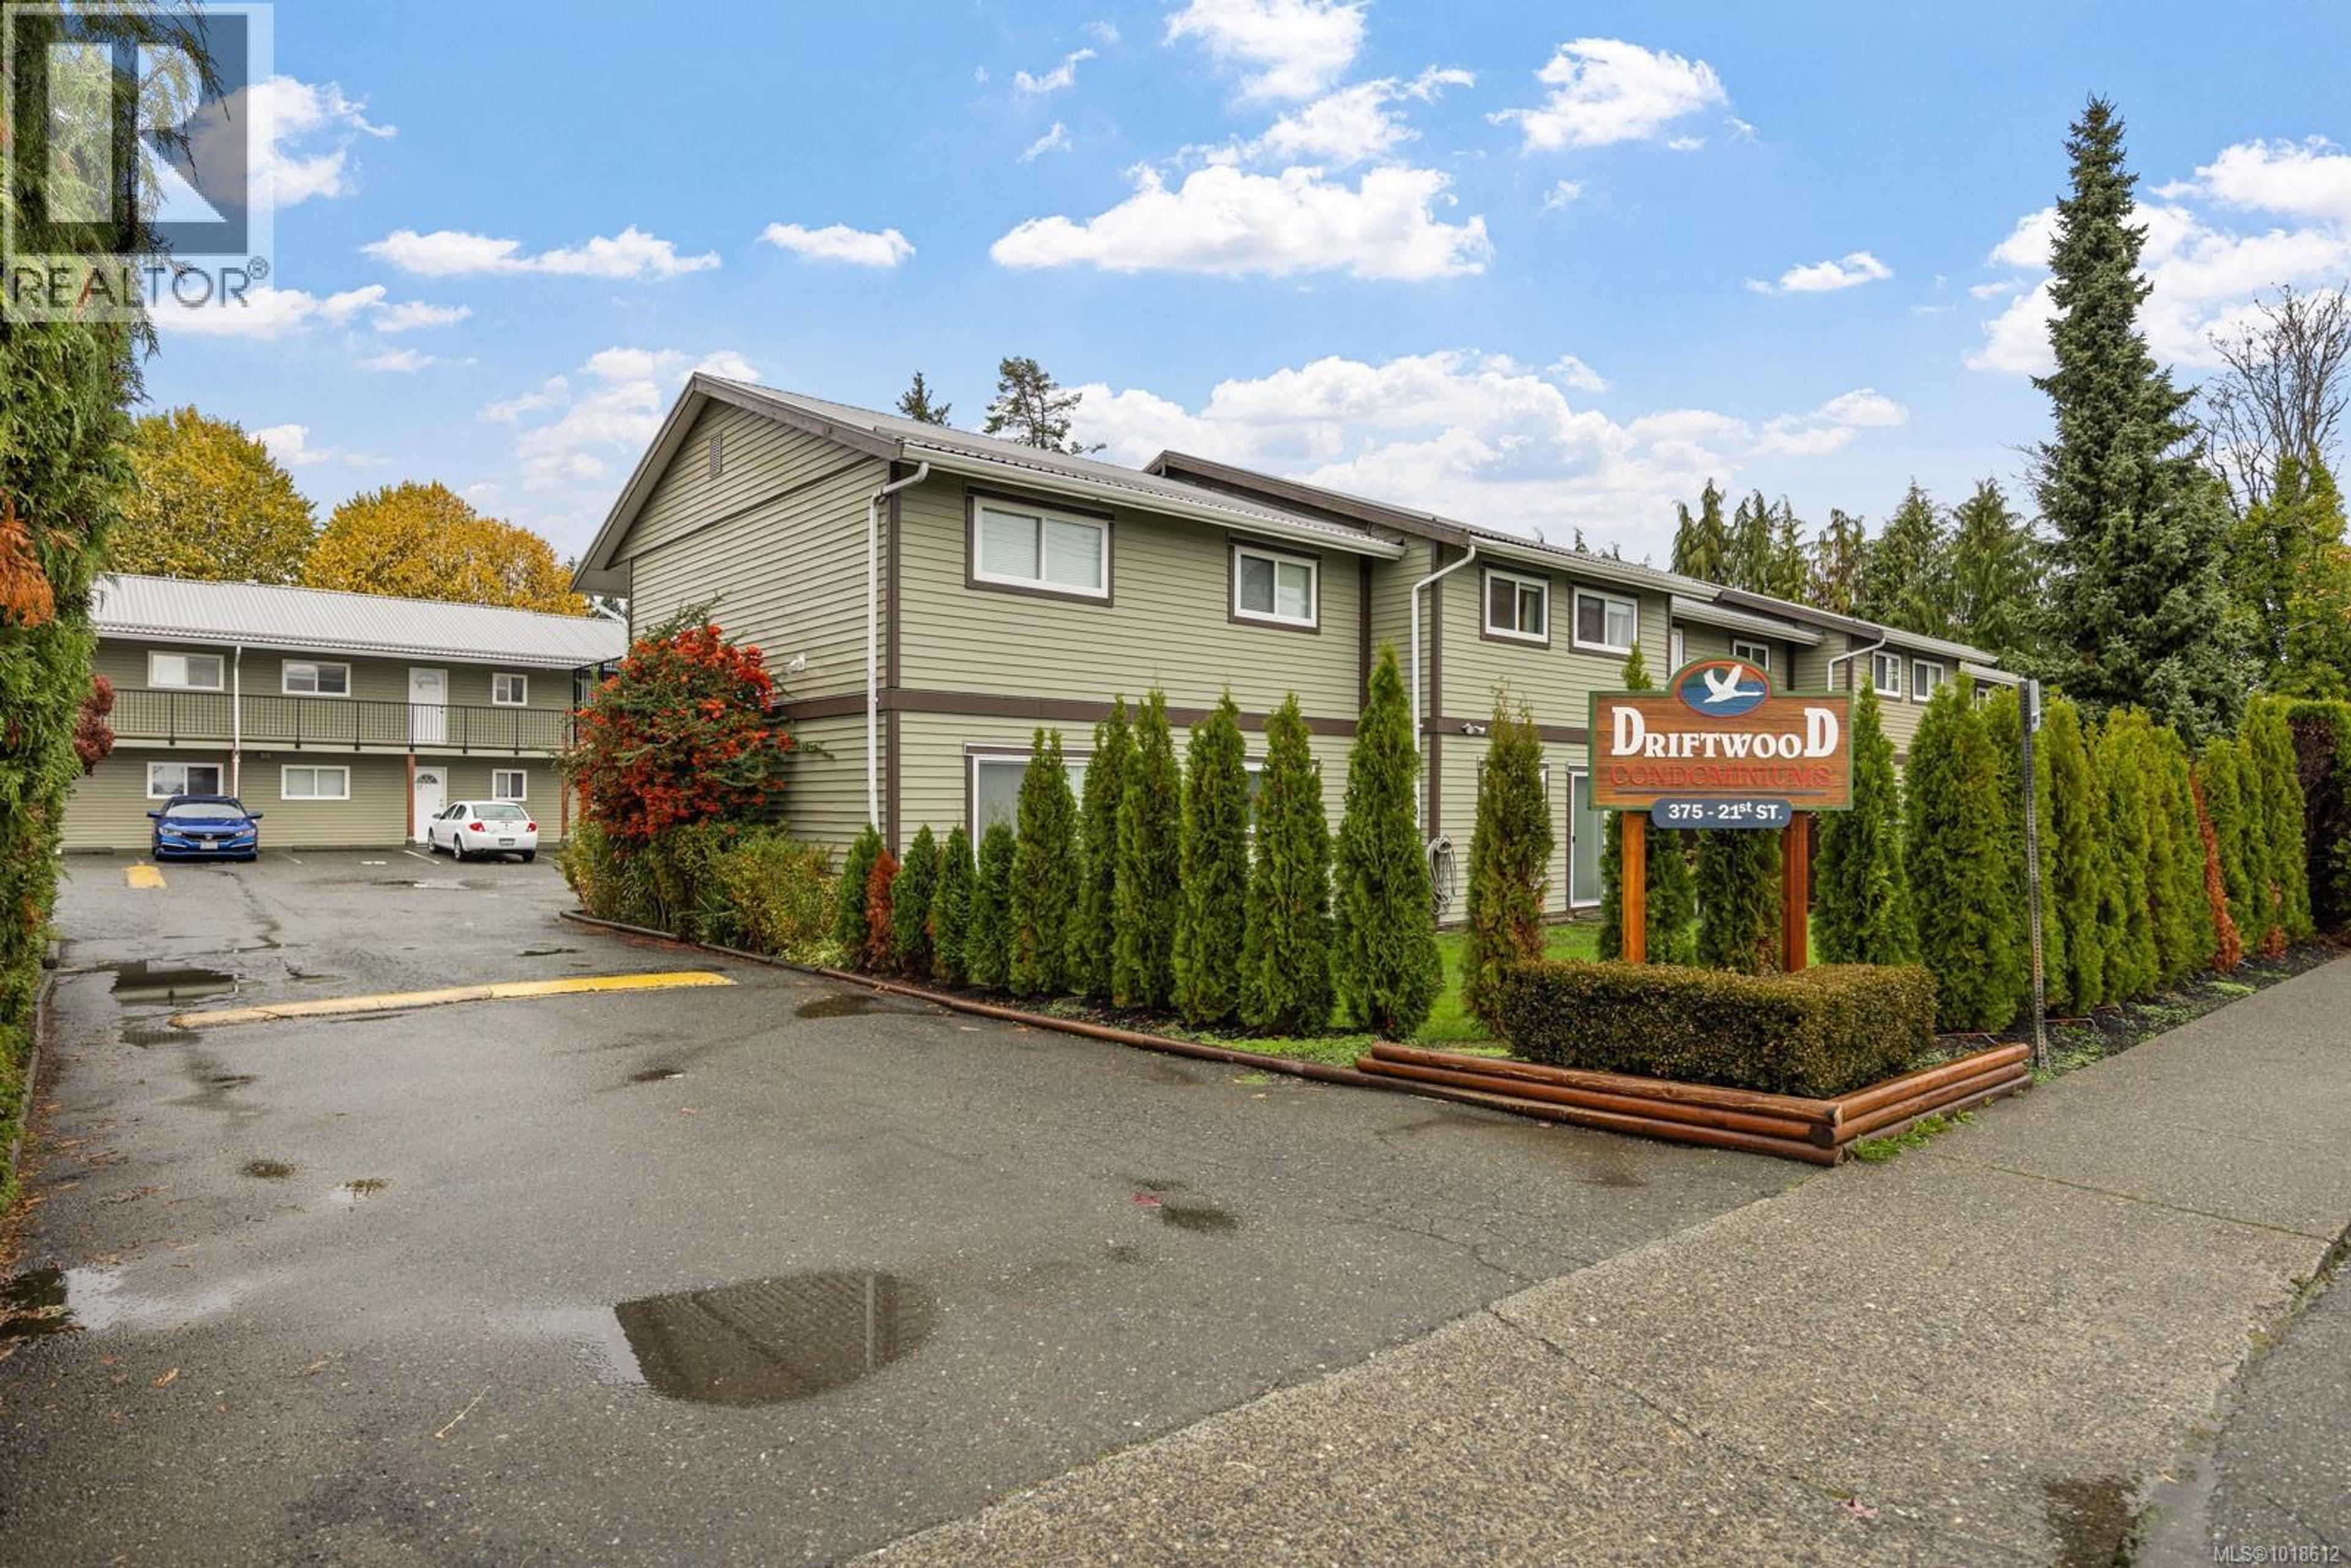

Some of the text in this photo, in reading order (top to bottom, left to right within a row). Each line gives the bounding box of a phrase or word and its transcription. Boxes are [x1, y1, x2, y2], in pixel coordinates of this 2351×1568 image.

[1610, 763, 1834, 787] CONDOMINIUMS
[1668, 804, 1703, 820] 375
[1718, 801, 1752, 820] 21st
[1755, 804, 1783, 820] ST.
